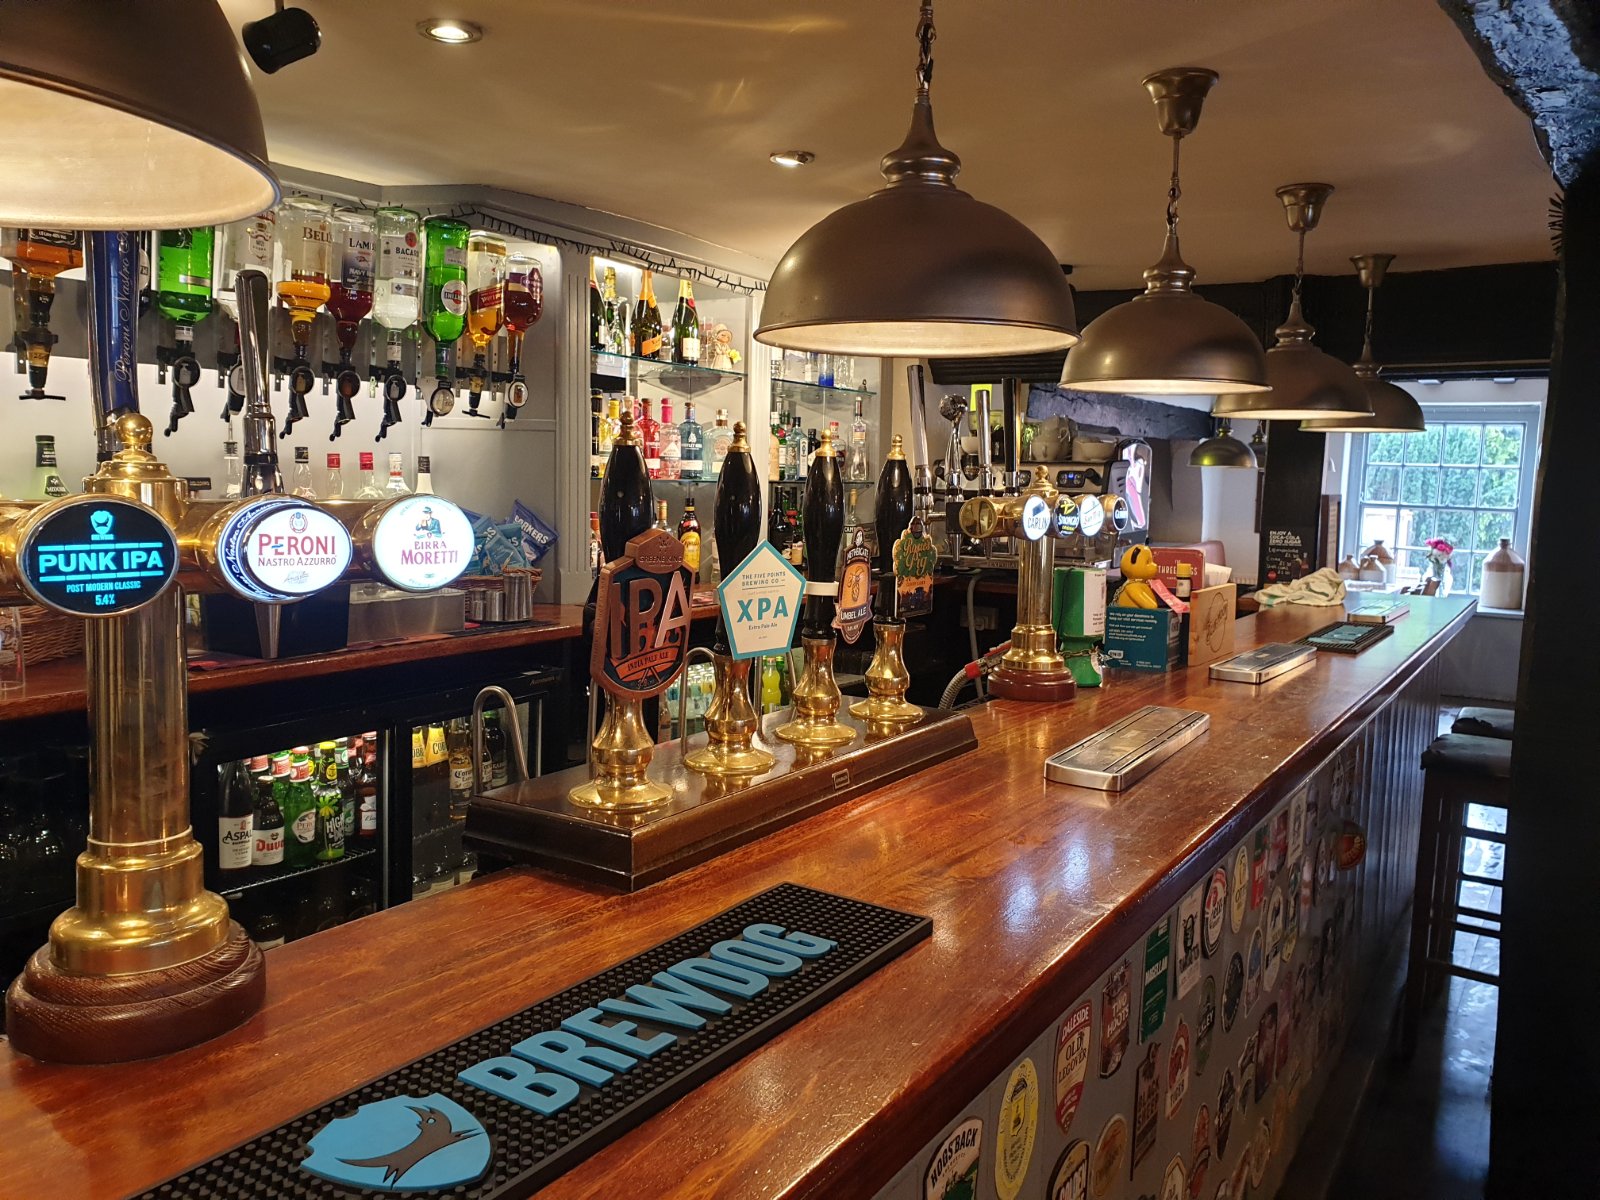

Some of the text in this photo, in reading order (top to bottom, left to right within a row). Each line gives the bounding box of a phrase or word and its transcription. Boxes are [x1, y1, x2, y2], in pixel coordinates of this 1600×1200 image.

[396, 247, 419, 256] BACAR
[1027, 517, 1049, 529] CARLIN
[258, 534, 335, 555] PERONI
[414, 541, 447, 550] BIRRA
[39, 550, 164, 574] PUNK IPA
[258, 556, 337, 566] NASTRO AZZURRO
[401, 549, 458, 565] MORETTI
[640, 554, 683, 563] GREENE KING
[767, 571, 786, 579] POINTS
[1158, 565, 1176, 574] THREE
[66, 580, 141, 593] POST MODERN CLASSIC
[95, 594, 116, 606] 5.4%
[737, 596, 789, 623] XPA
[841, 606, 867, 621] UMBEL ALE
[658, 650, 669, 660] ALE
[433, 741, 448, 755] COB
[1112, 993, 1127, 1017] TWO
[457, 923, 838, 1116] BREWDOG
[1061, 1007, 1090, 1042] DALESIDE
[1107, 1004, 1130, 1038] HOOTS
[1066, 1035, 1082, 1062] OLD
[1058, 1048, 1087, 1083] LEGOVER
[931, 1143, 956, 1189] HOGS
[954, 1127, 979, 1154] BACK
